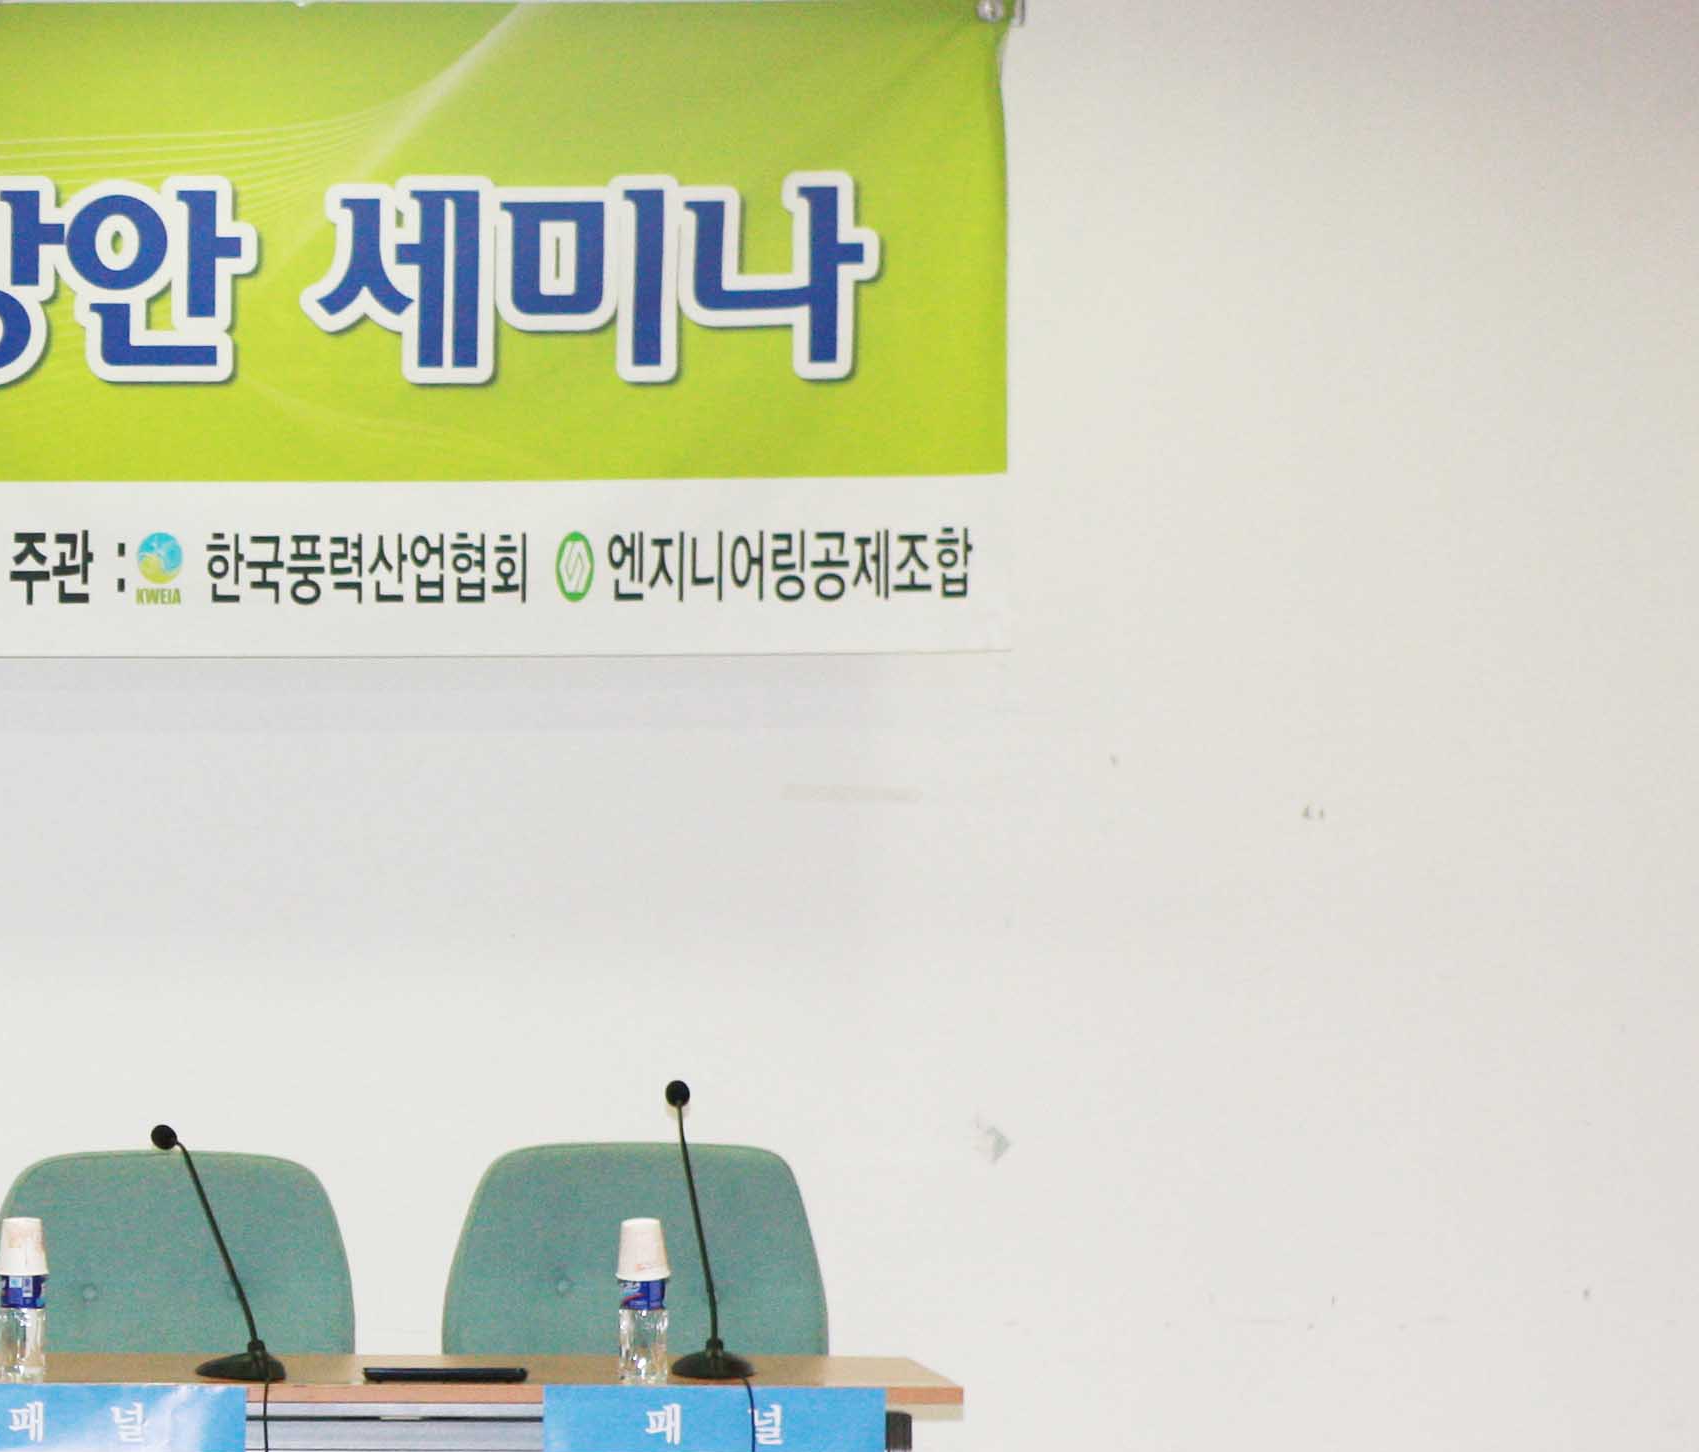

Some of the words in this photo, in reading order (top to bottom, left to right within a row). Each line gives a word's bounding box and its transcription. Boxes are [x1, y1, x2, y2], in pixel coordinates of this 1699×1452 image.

[311, 176, 875, 380] 세미나
[9, 529, 95, 606] 주관
[205, 532, 528, 606] 한국풍력산업협회
[607, 527, 974, 602] 엔지니어링공제조합
